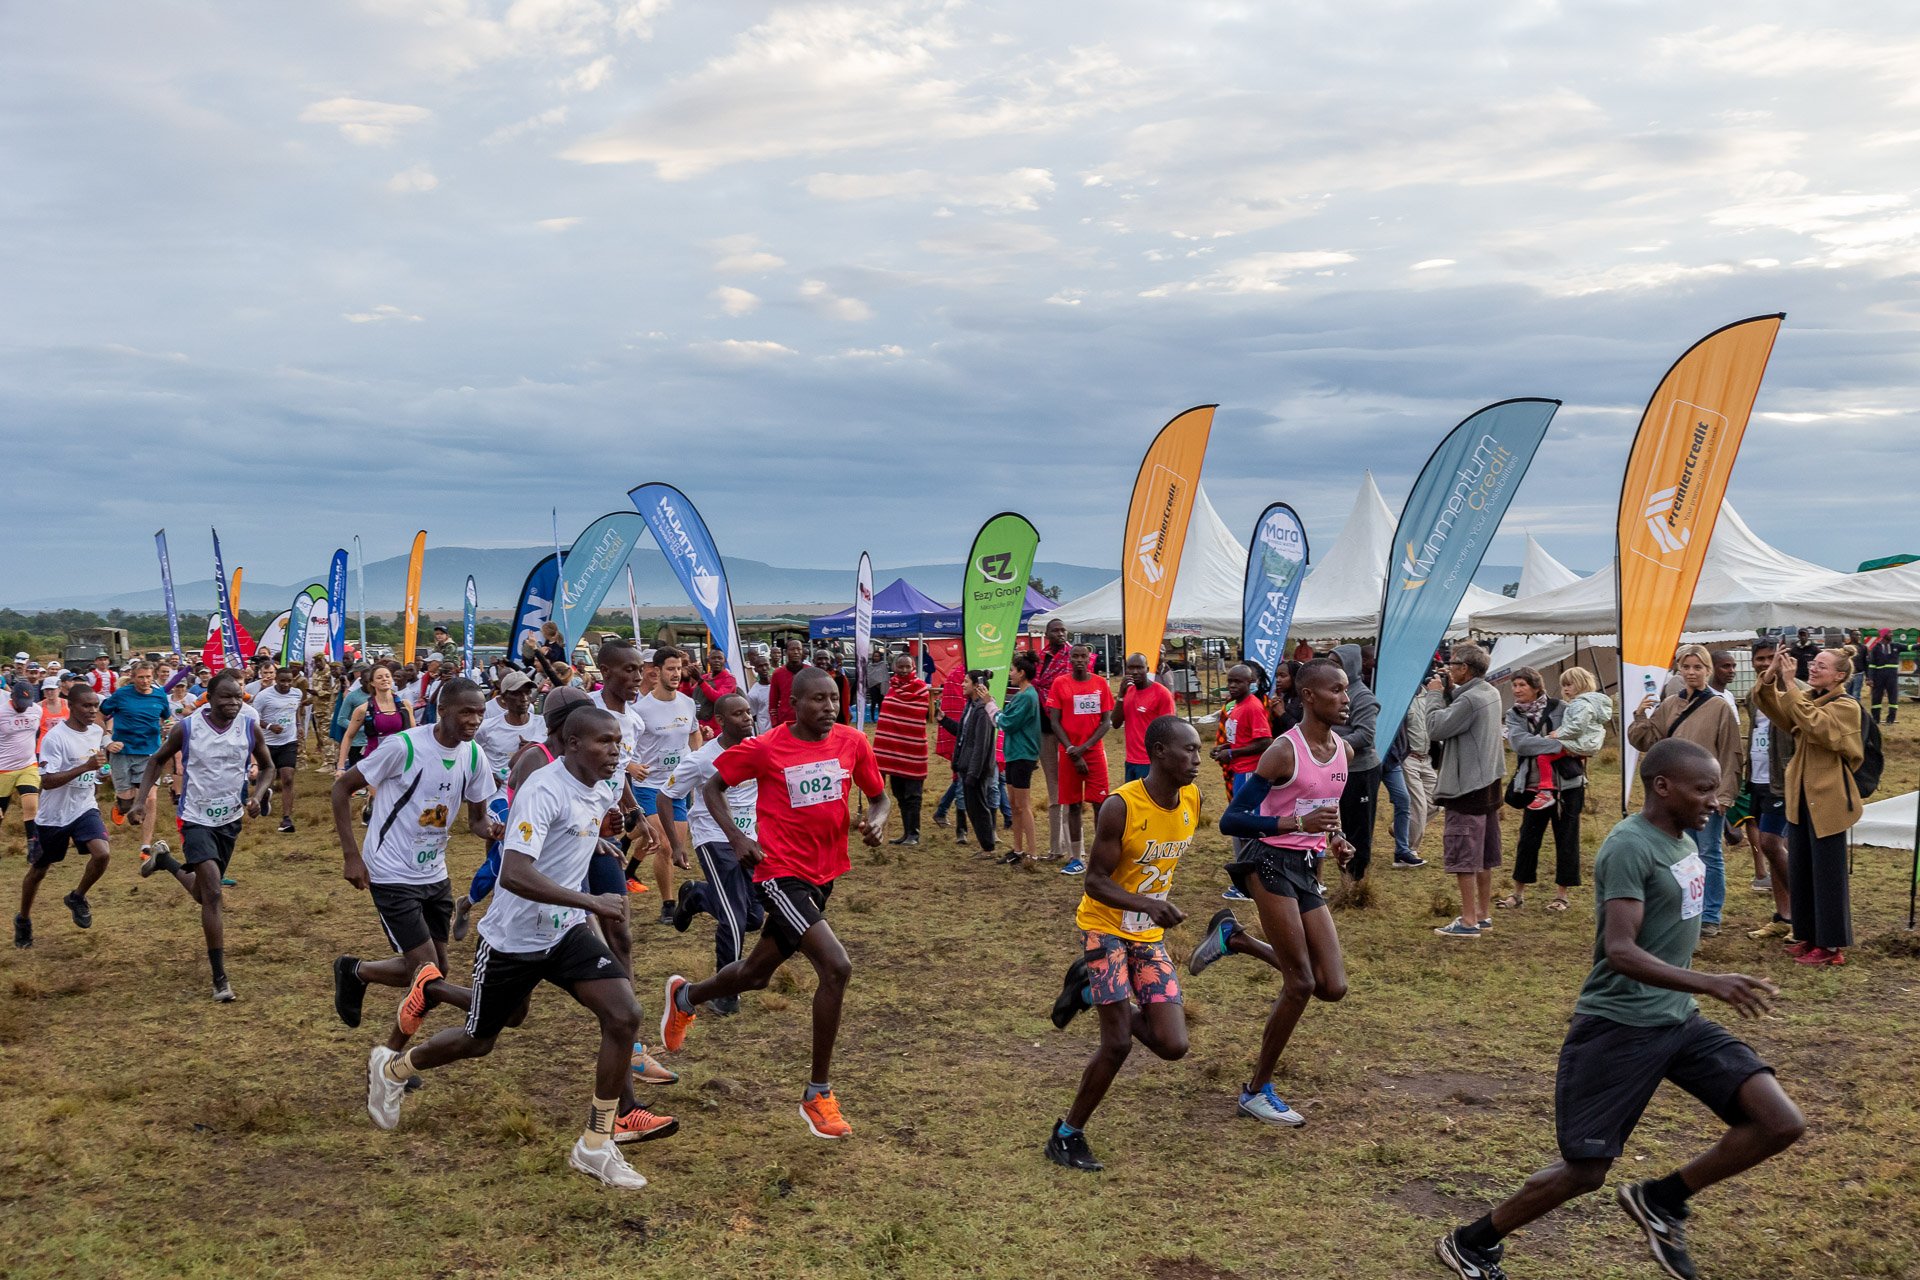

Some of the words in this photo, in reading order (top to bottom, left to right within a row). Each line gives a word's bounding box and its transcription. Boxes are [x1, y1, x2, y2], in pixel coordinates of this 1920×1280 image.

[1415, 434, 1498, 572] Momentum
[1468, 446, 1511, 511] Credit
[1668, 421, 1709, 528] PremierCredit
[600, 535, 624, 570] Credit
[1153, 483, 1176, 563] PremierCredit
[1265, 522, 1299, 543] Mara
[1443, 539, 1476, 590] Expanding
[1470, 513, 1490, 537] Your
[1483, 455, 1520, 514] Possibilities
[567, 528, 617, 602] Momentum
[982, 552, 1012, 583] EZ
[1250, 591, 1284, 669] ARA
[1265, 640, 1278, 677] RINGS
[1274, 593, 1289, 636] WATER
[663, 756, 680, 765] 081
[800, 776, 832, 795] 082
[1331, 772, 1346, 782] PEU
[206, 806, 228, 817] 093
